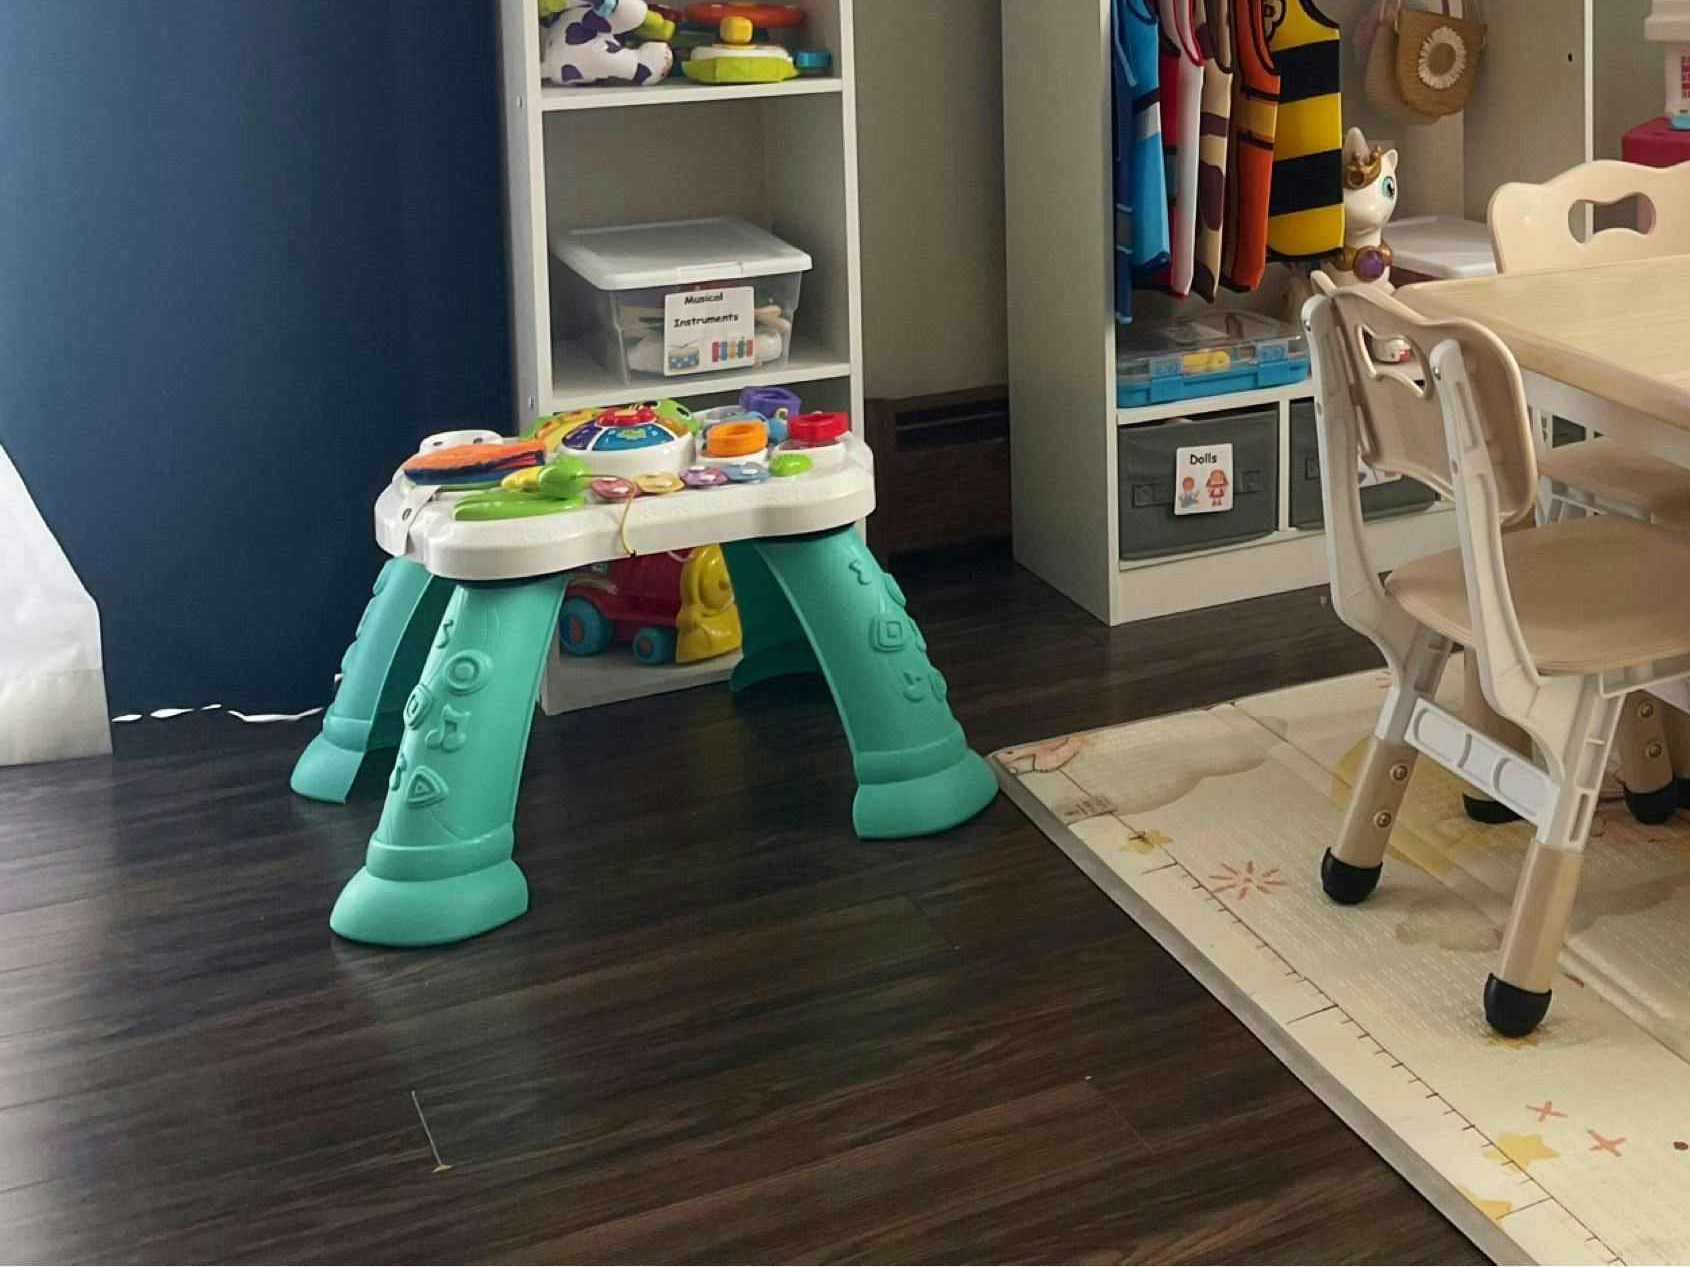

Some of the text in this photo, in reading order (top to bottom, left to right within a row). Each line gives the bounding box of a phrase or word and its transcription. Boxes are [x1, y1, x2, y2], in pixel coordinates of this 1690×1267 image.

[684, 291, 724, 305] Musical
[673, 312, 740, 329] Instruments
[1189, 452, 1218, 466] Dolls
